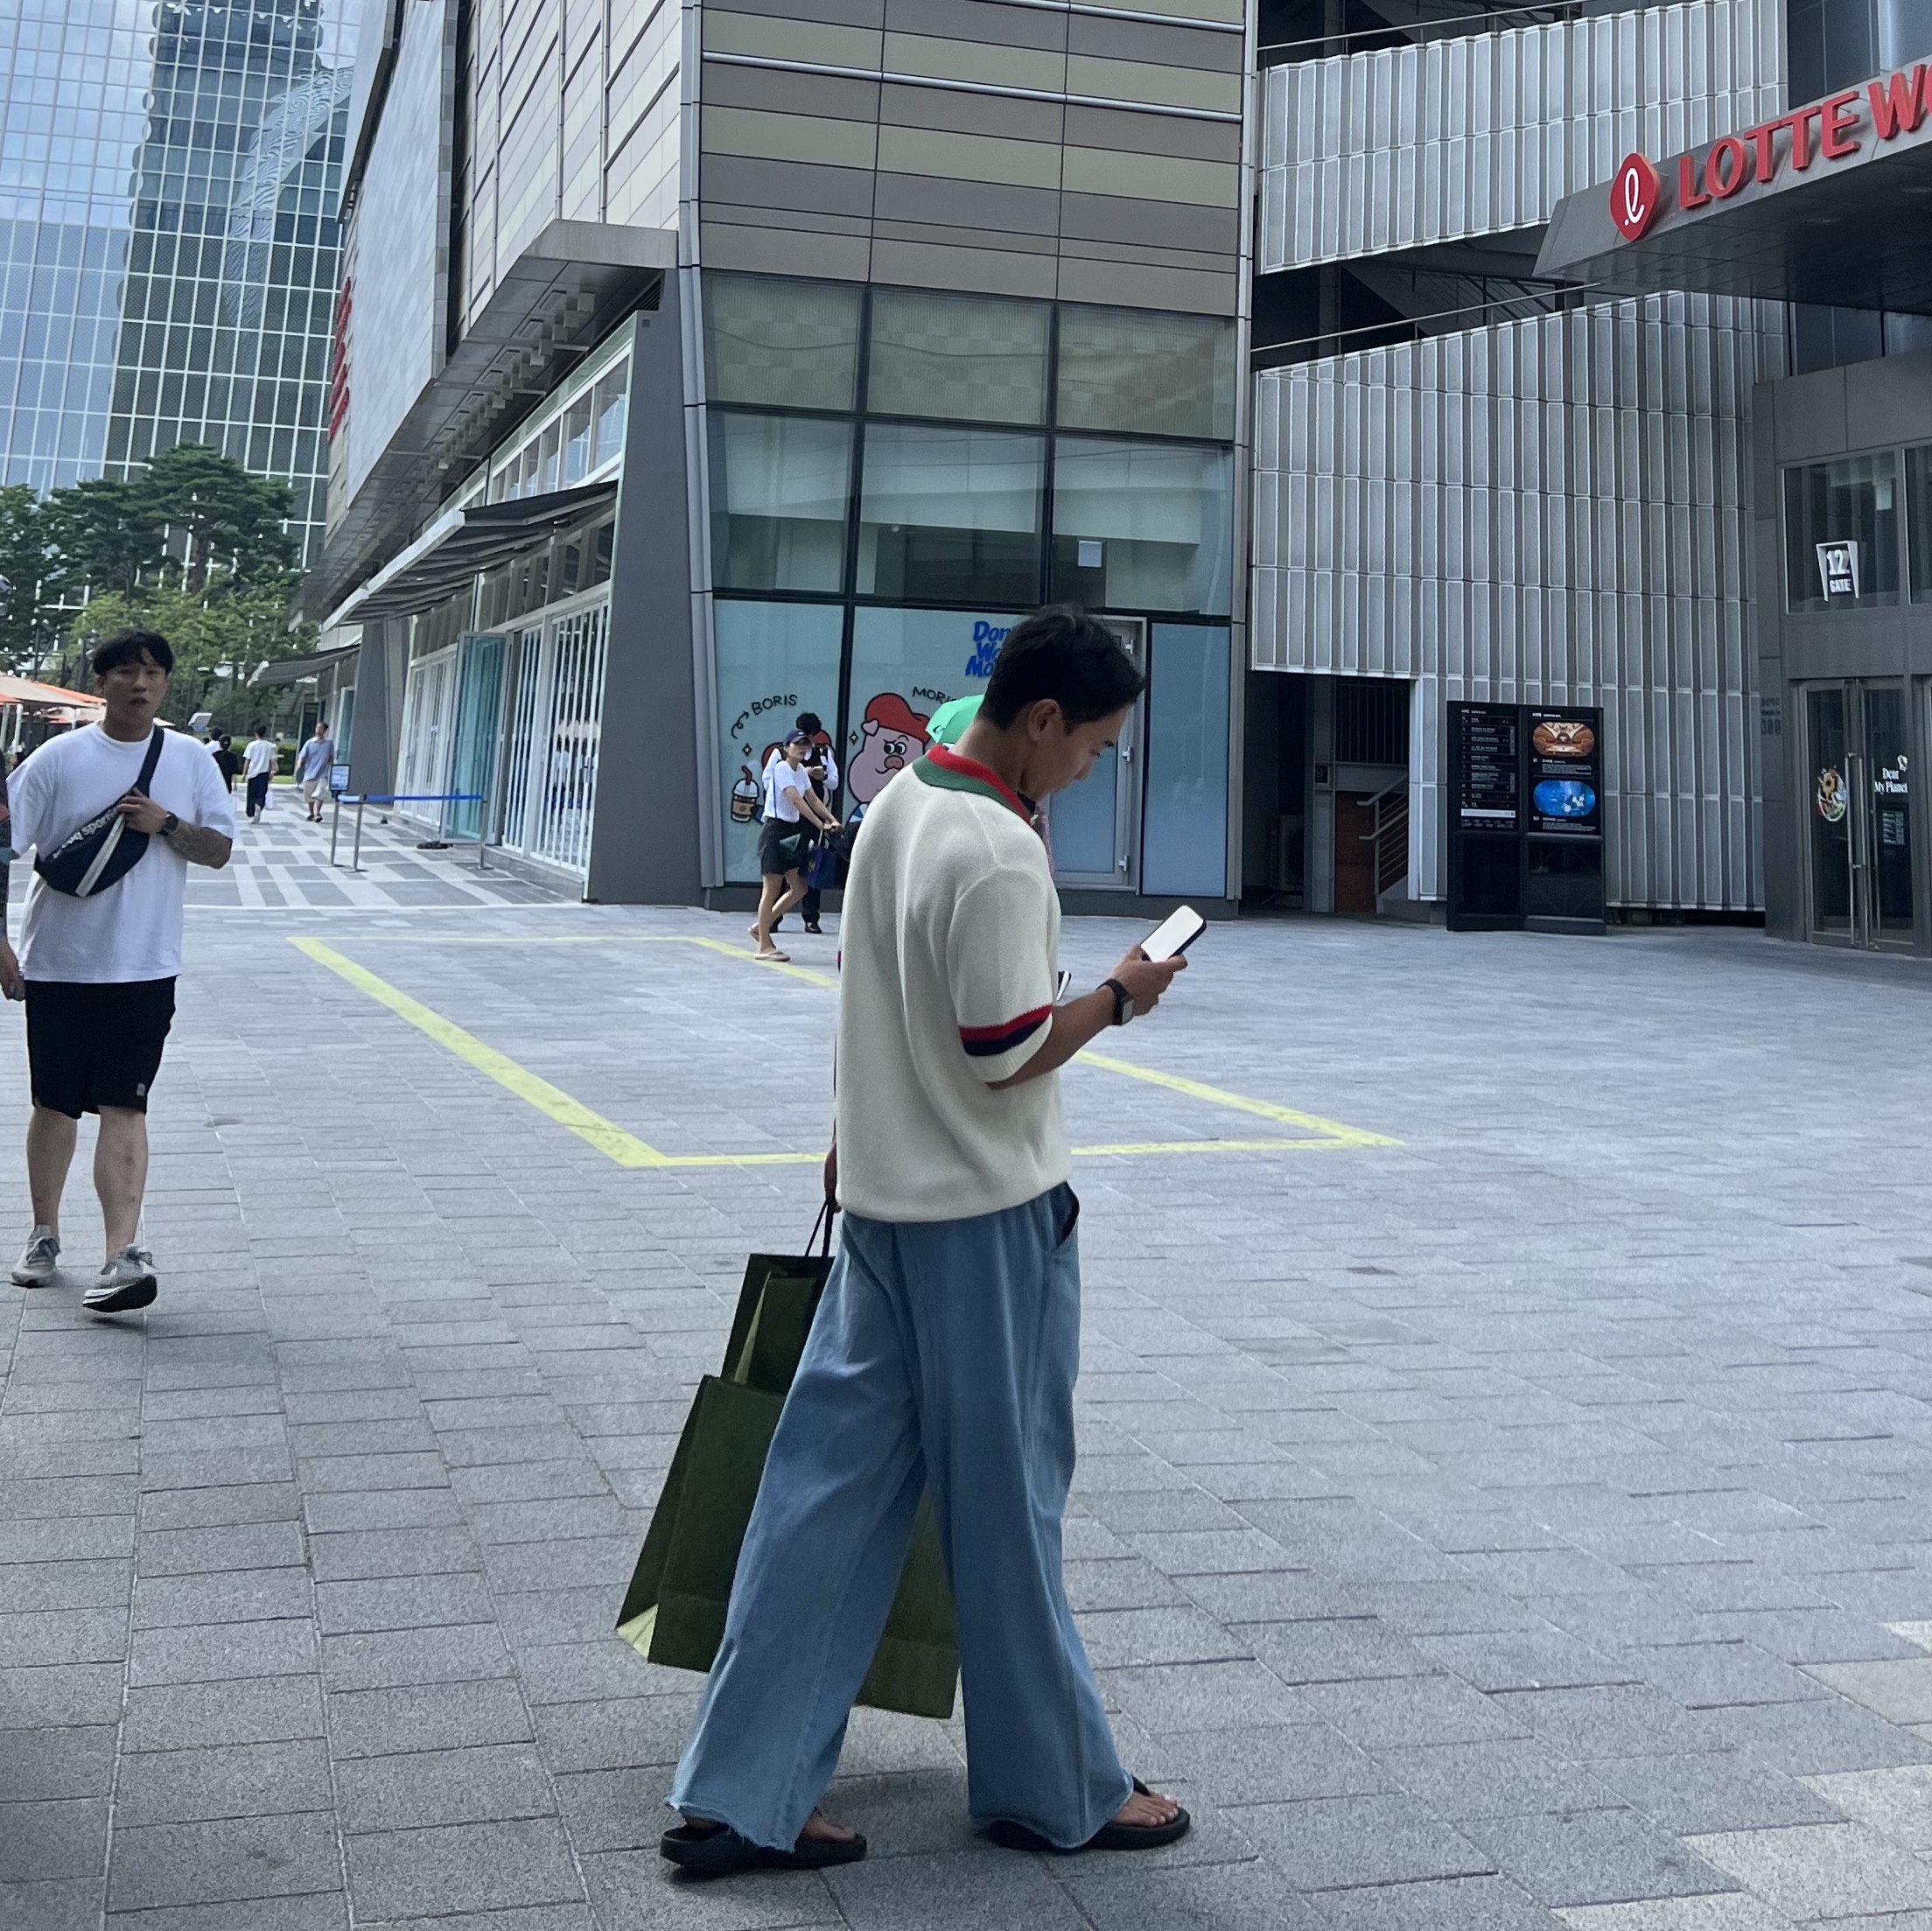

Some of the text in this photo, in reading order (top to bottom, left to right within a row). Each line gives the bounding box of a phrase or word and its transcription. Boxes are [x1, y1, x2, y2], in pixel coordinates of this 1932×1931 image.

[1678, 90, 1861, 209] LOTTE
[1826, 549, 1851, 576] 12
[1829, 578, 1852, 594] GATE
[751, 693, 798, 716] BORIS
[912, 686, 958, 705] MORI
